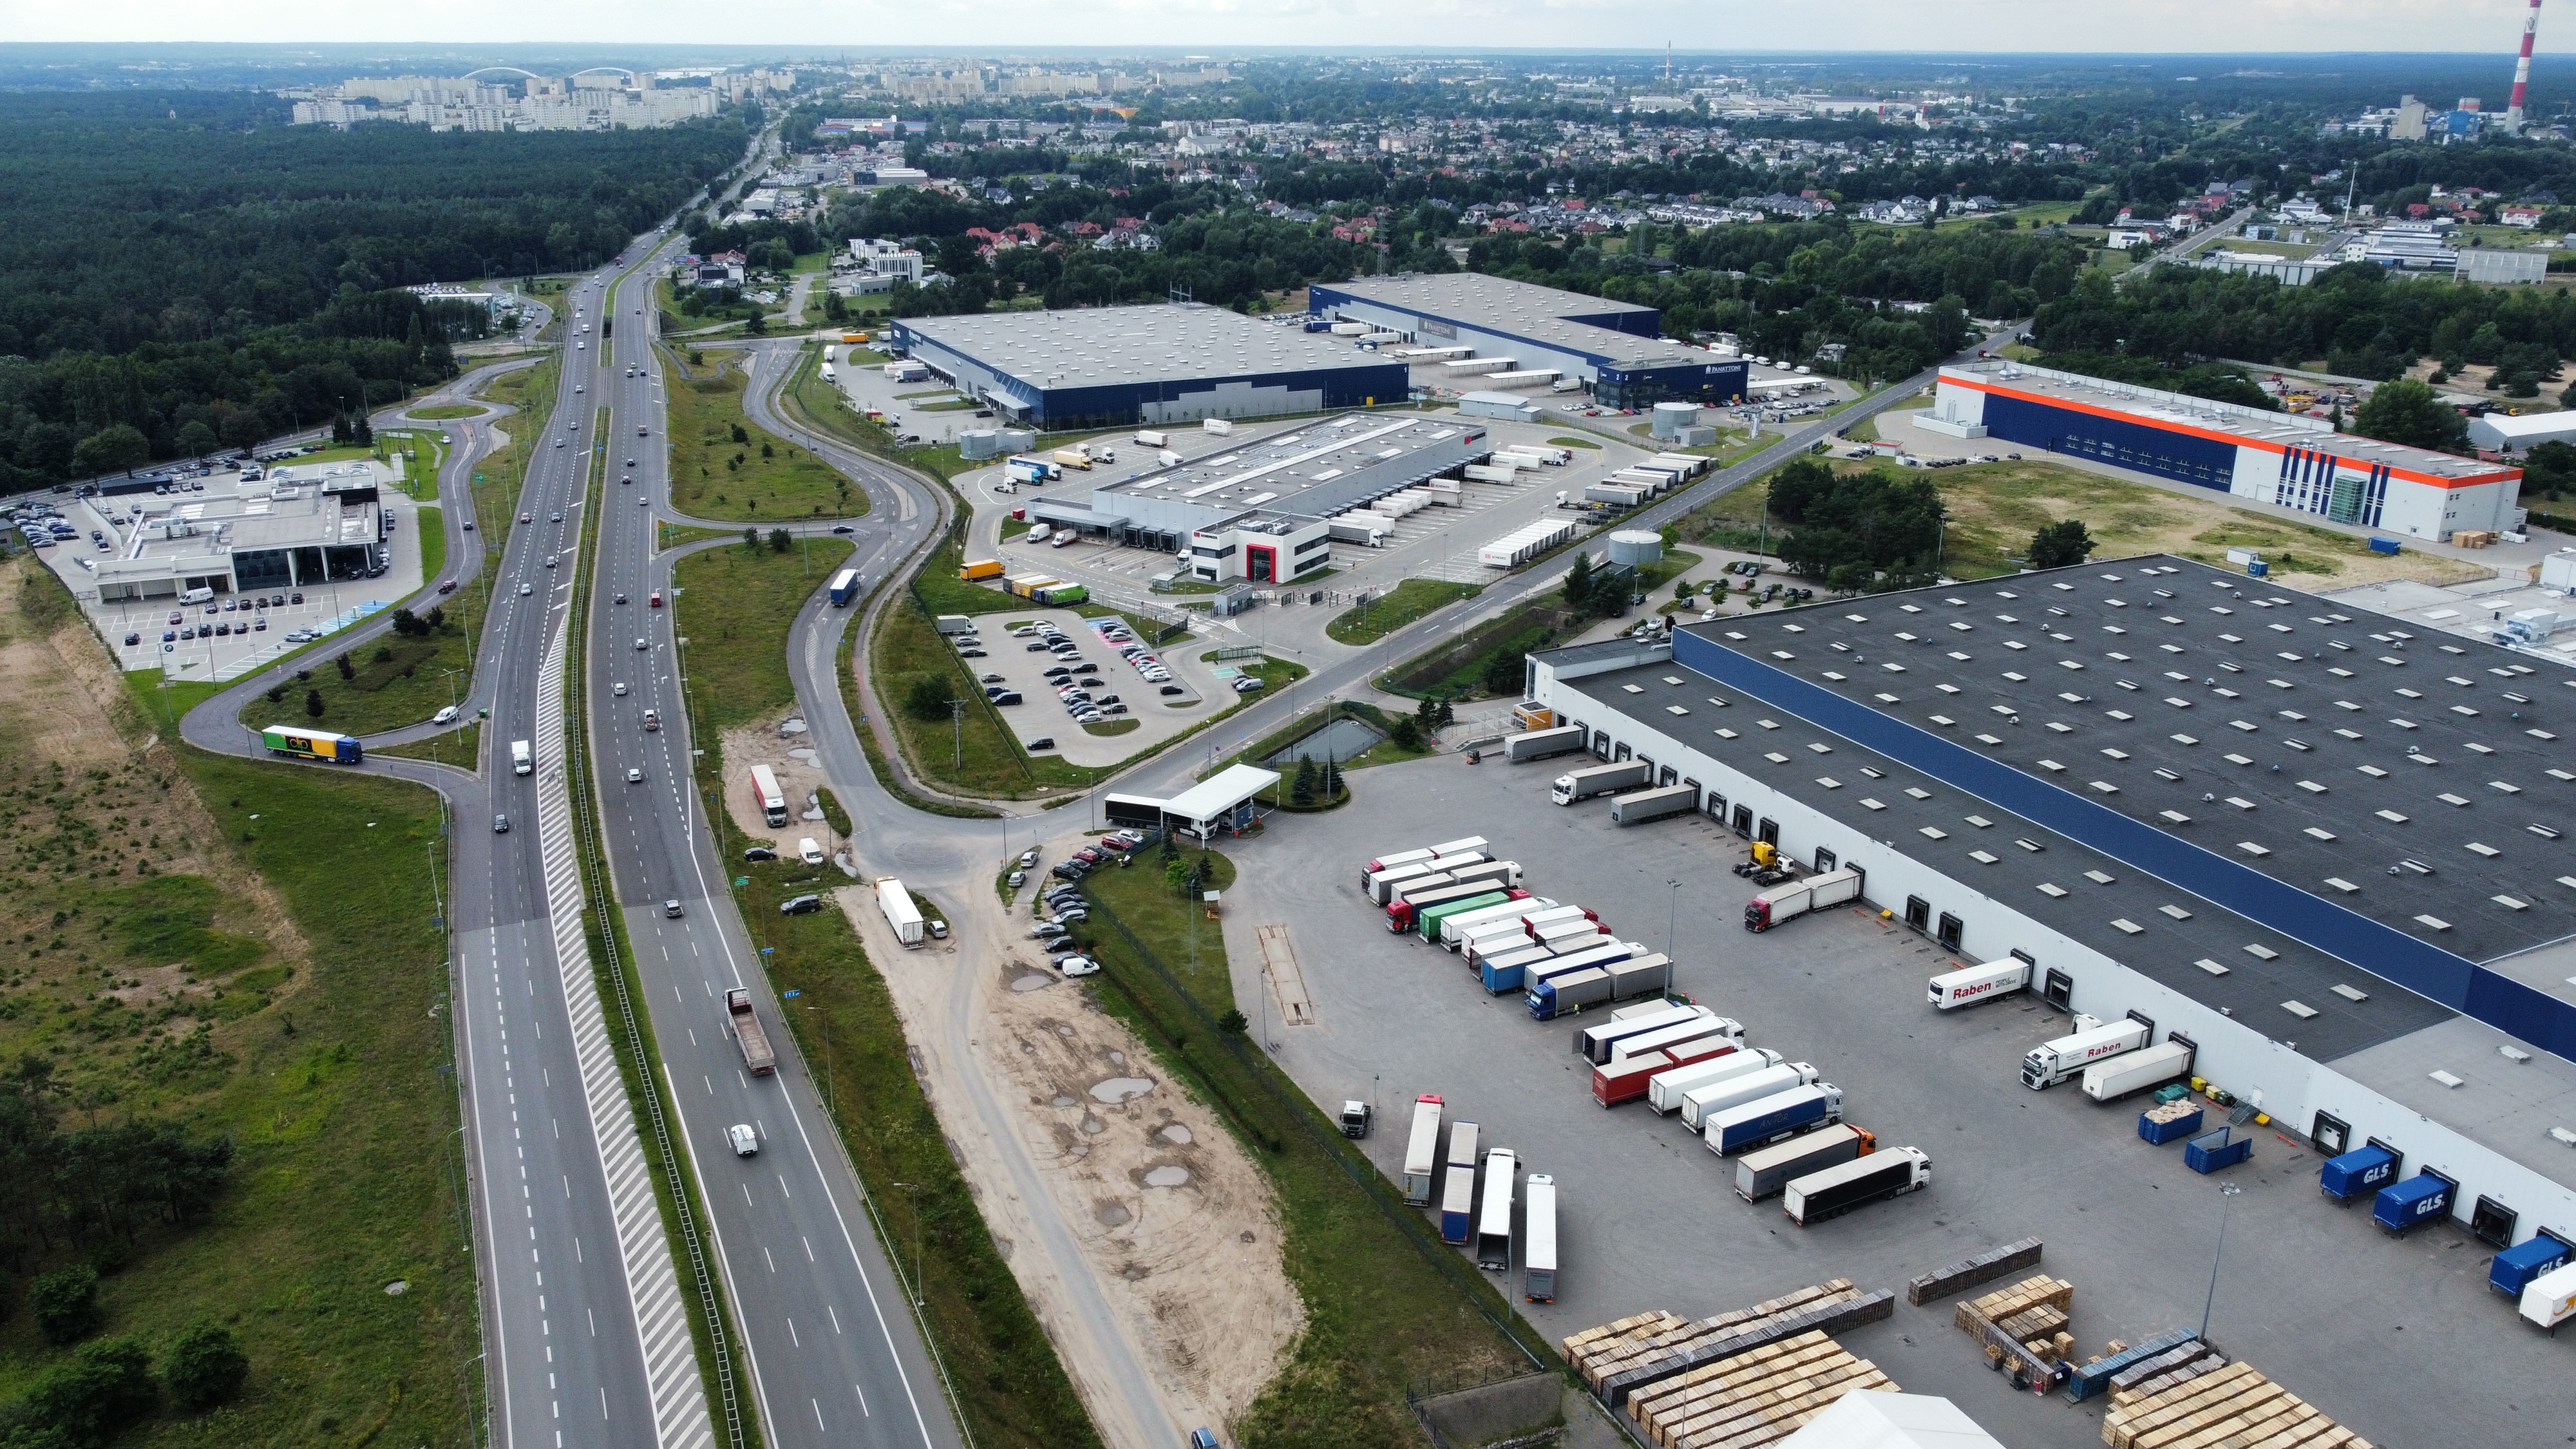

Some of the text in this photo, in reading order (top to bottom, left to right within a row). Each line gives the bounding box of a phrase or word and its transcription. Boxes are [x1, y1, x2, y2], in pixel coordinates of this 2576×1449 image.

[1953, 982, 1991, 999] Raben
[2087, 1043, 2121, 1057] Raben
[2363, 1164, 2389, 1184] GLS
[2416, 1194, 2443, 1215] GLS
[2537, 1256, 2564, 1278] GLS
